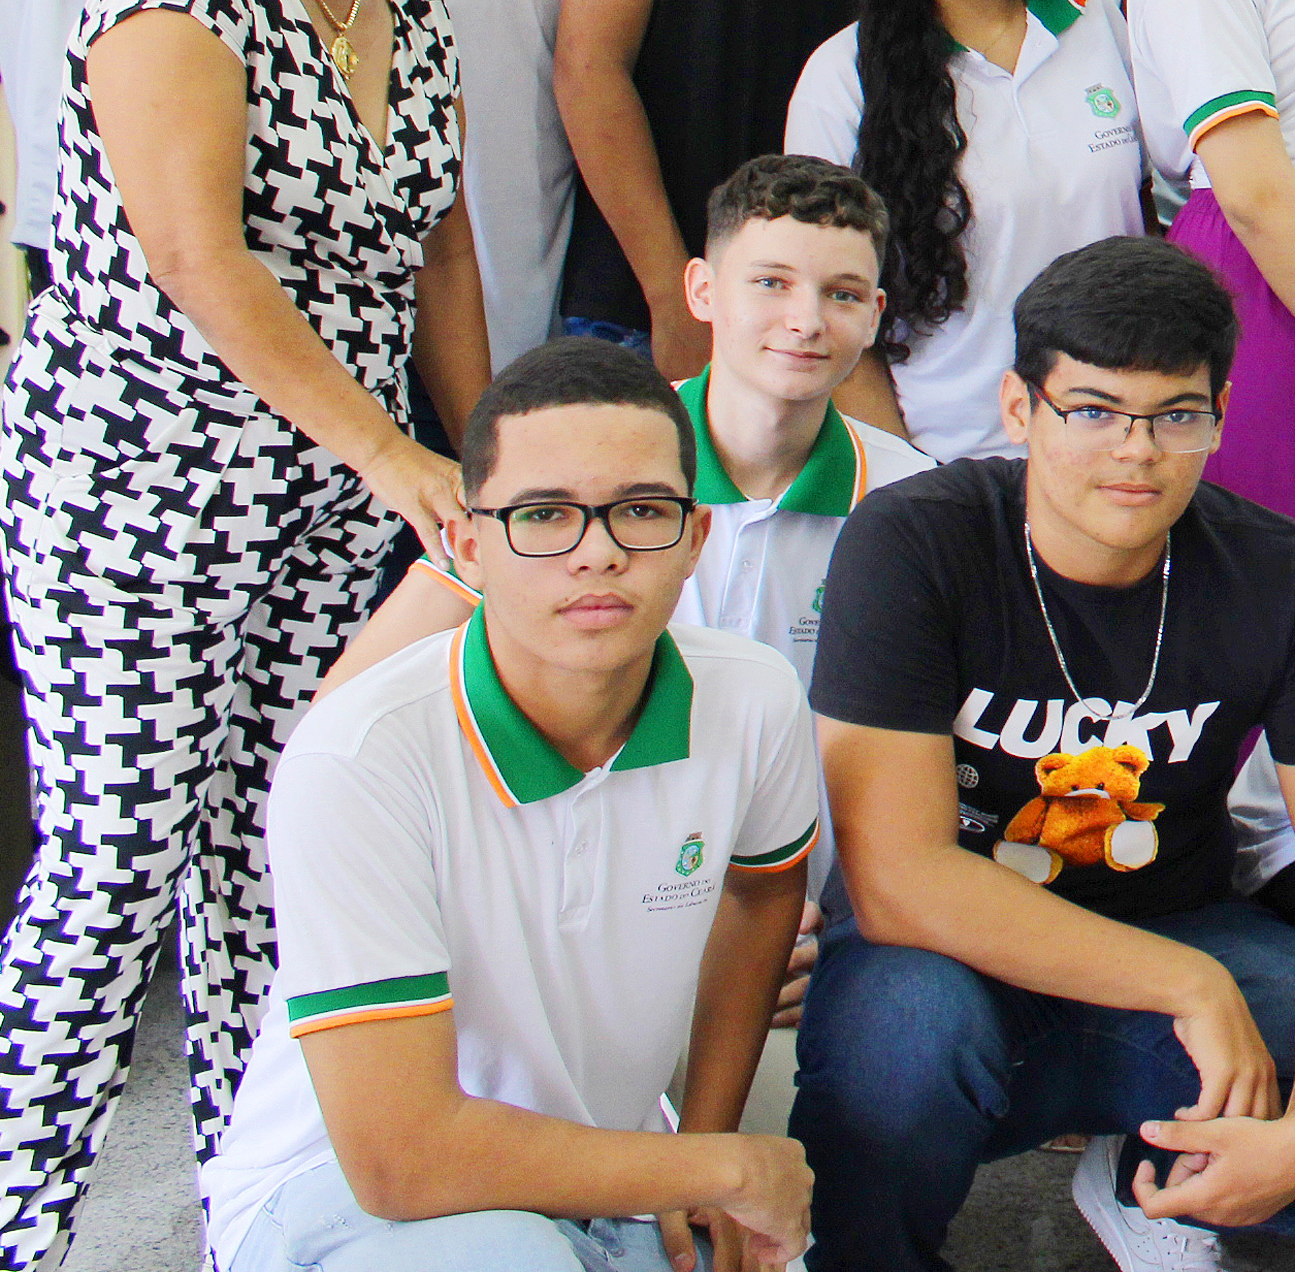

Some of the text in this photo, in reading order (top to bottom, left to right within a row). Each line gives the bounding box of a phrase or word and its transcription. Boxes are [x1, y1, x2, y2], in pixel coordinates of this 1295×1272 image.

[1088, 139, 1121, 153] ESTADO
[953, 687, 1221, 764] LUCKY
[657, 879, 701, 892] GOVERNO
[642, 893, 678, 904] ESTADO
